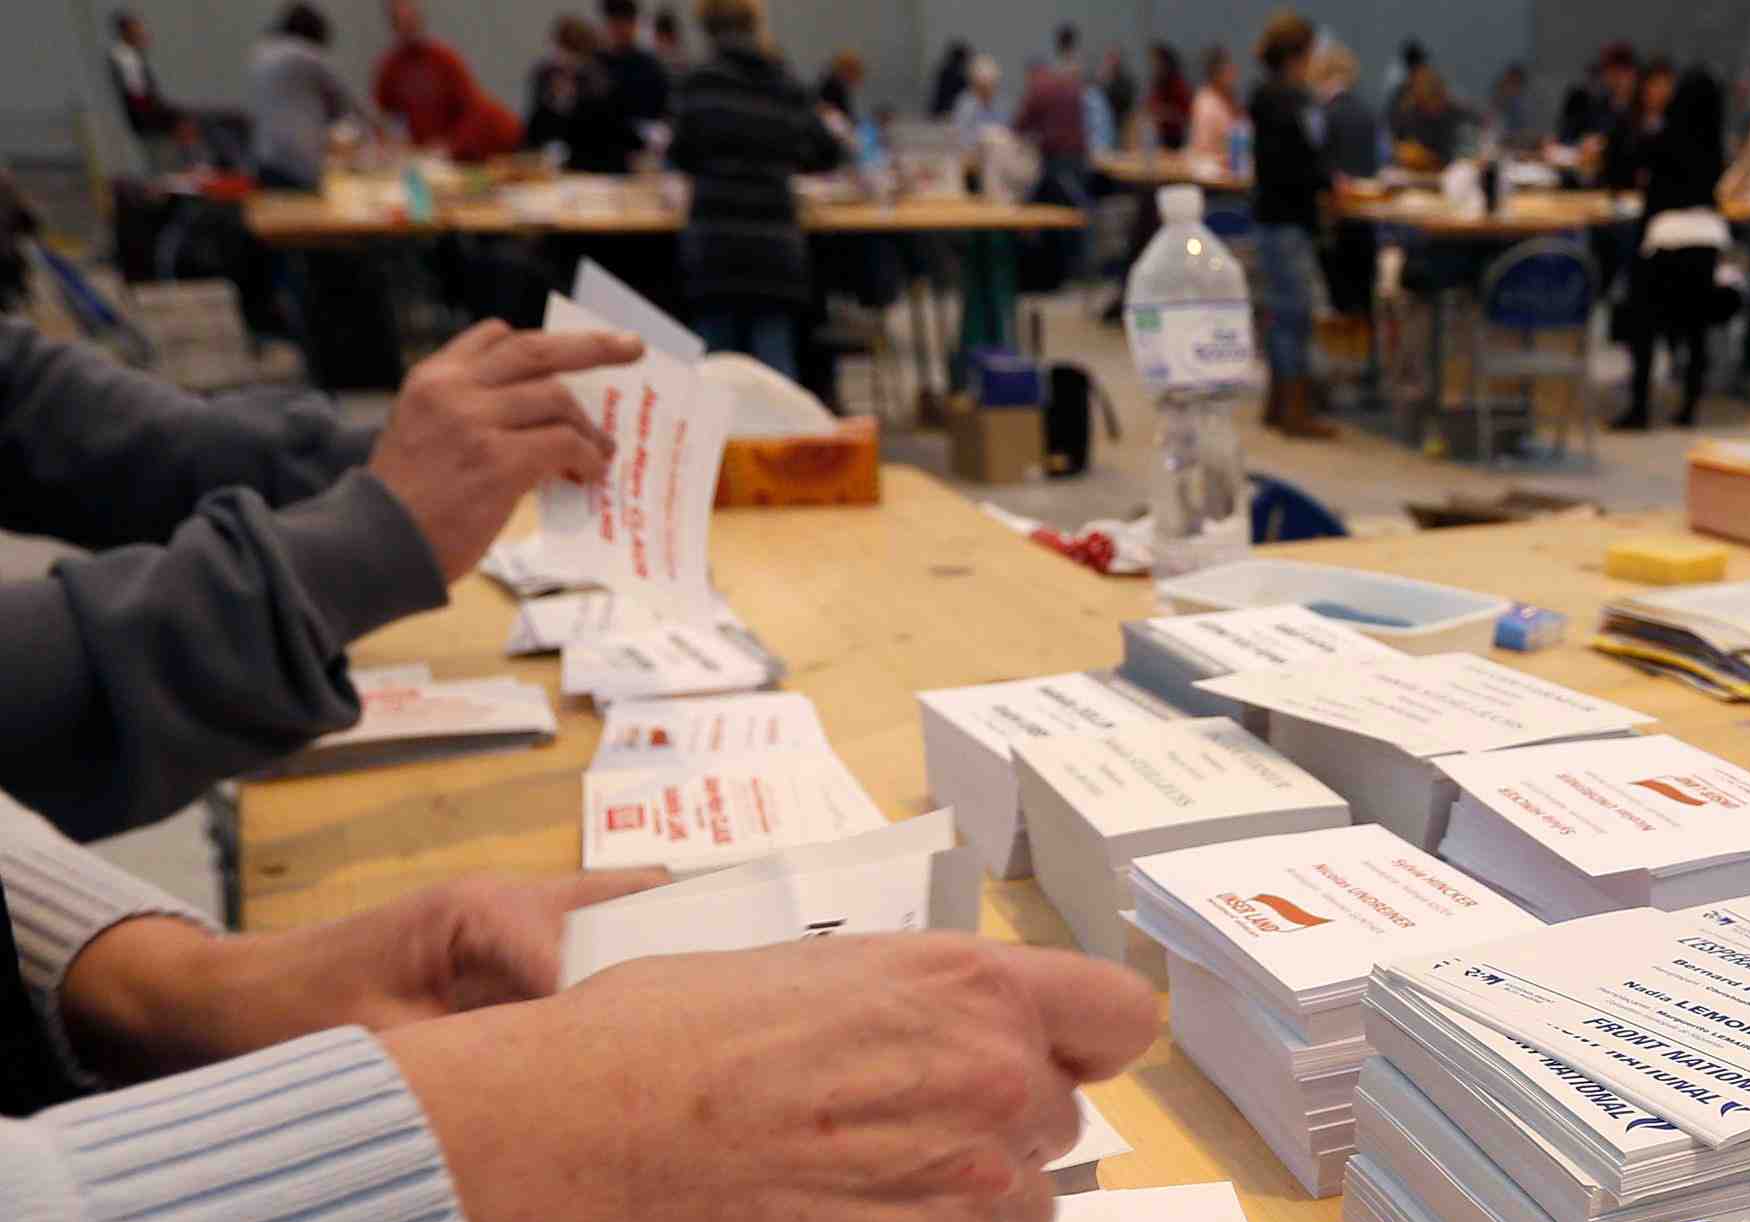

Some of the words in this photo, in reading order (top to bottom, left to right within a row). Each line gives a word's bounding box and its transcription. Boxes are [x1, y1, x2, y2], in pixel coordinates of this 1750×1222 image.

[1672, 959, 1743, 987] Bernard
[1624, 980, 1673, 1002] Nadia
[1583, 1017, 1671, 1049] FRONT
[1541, 1058, 1635, 1119] NATIONAL
